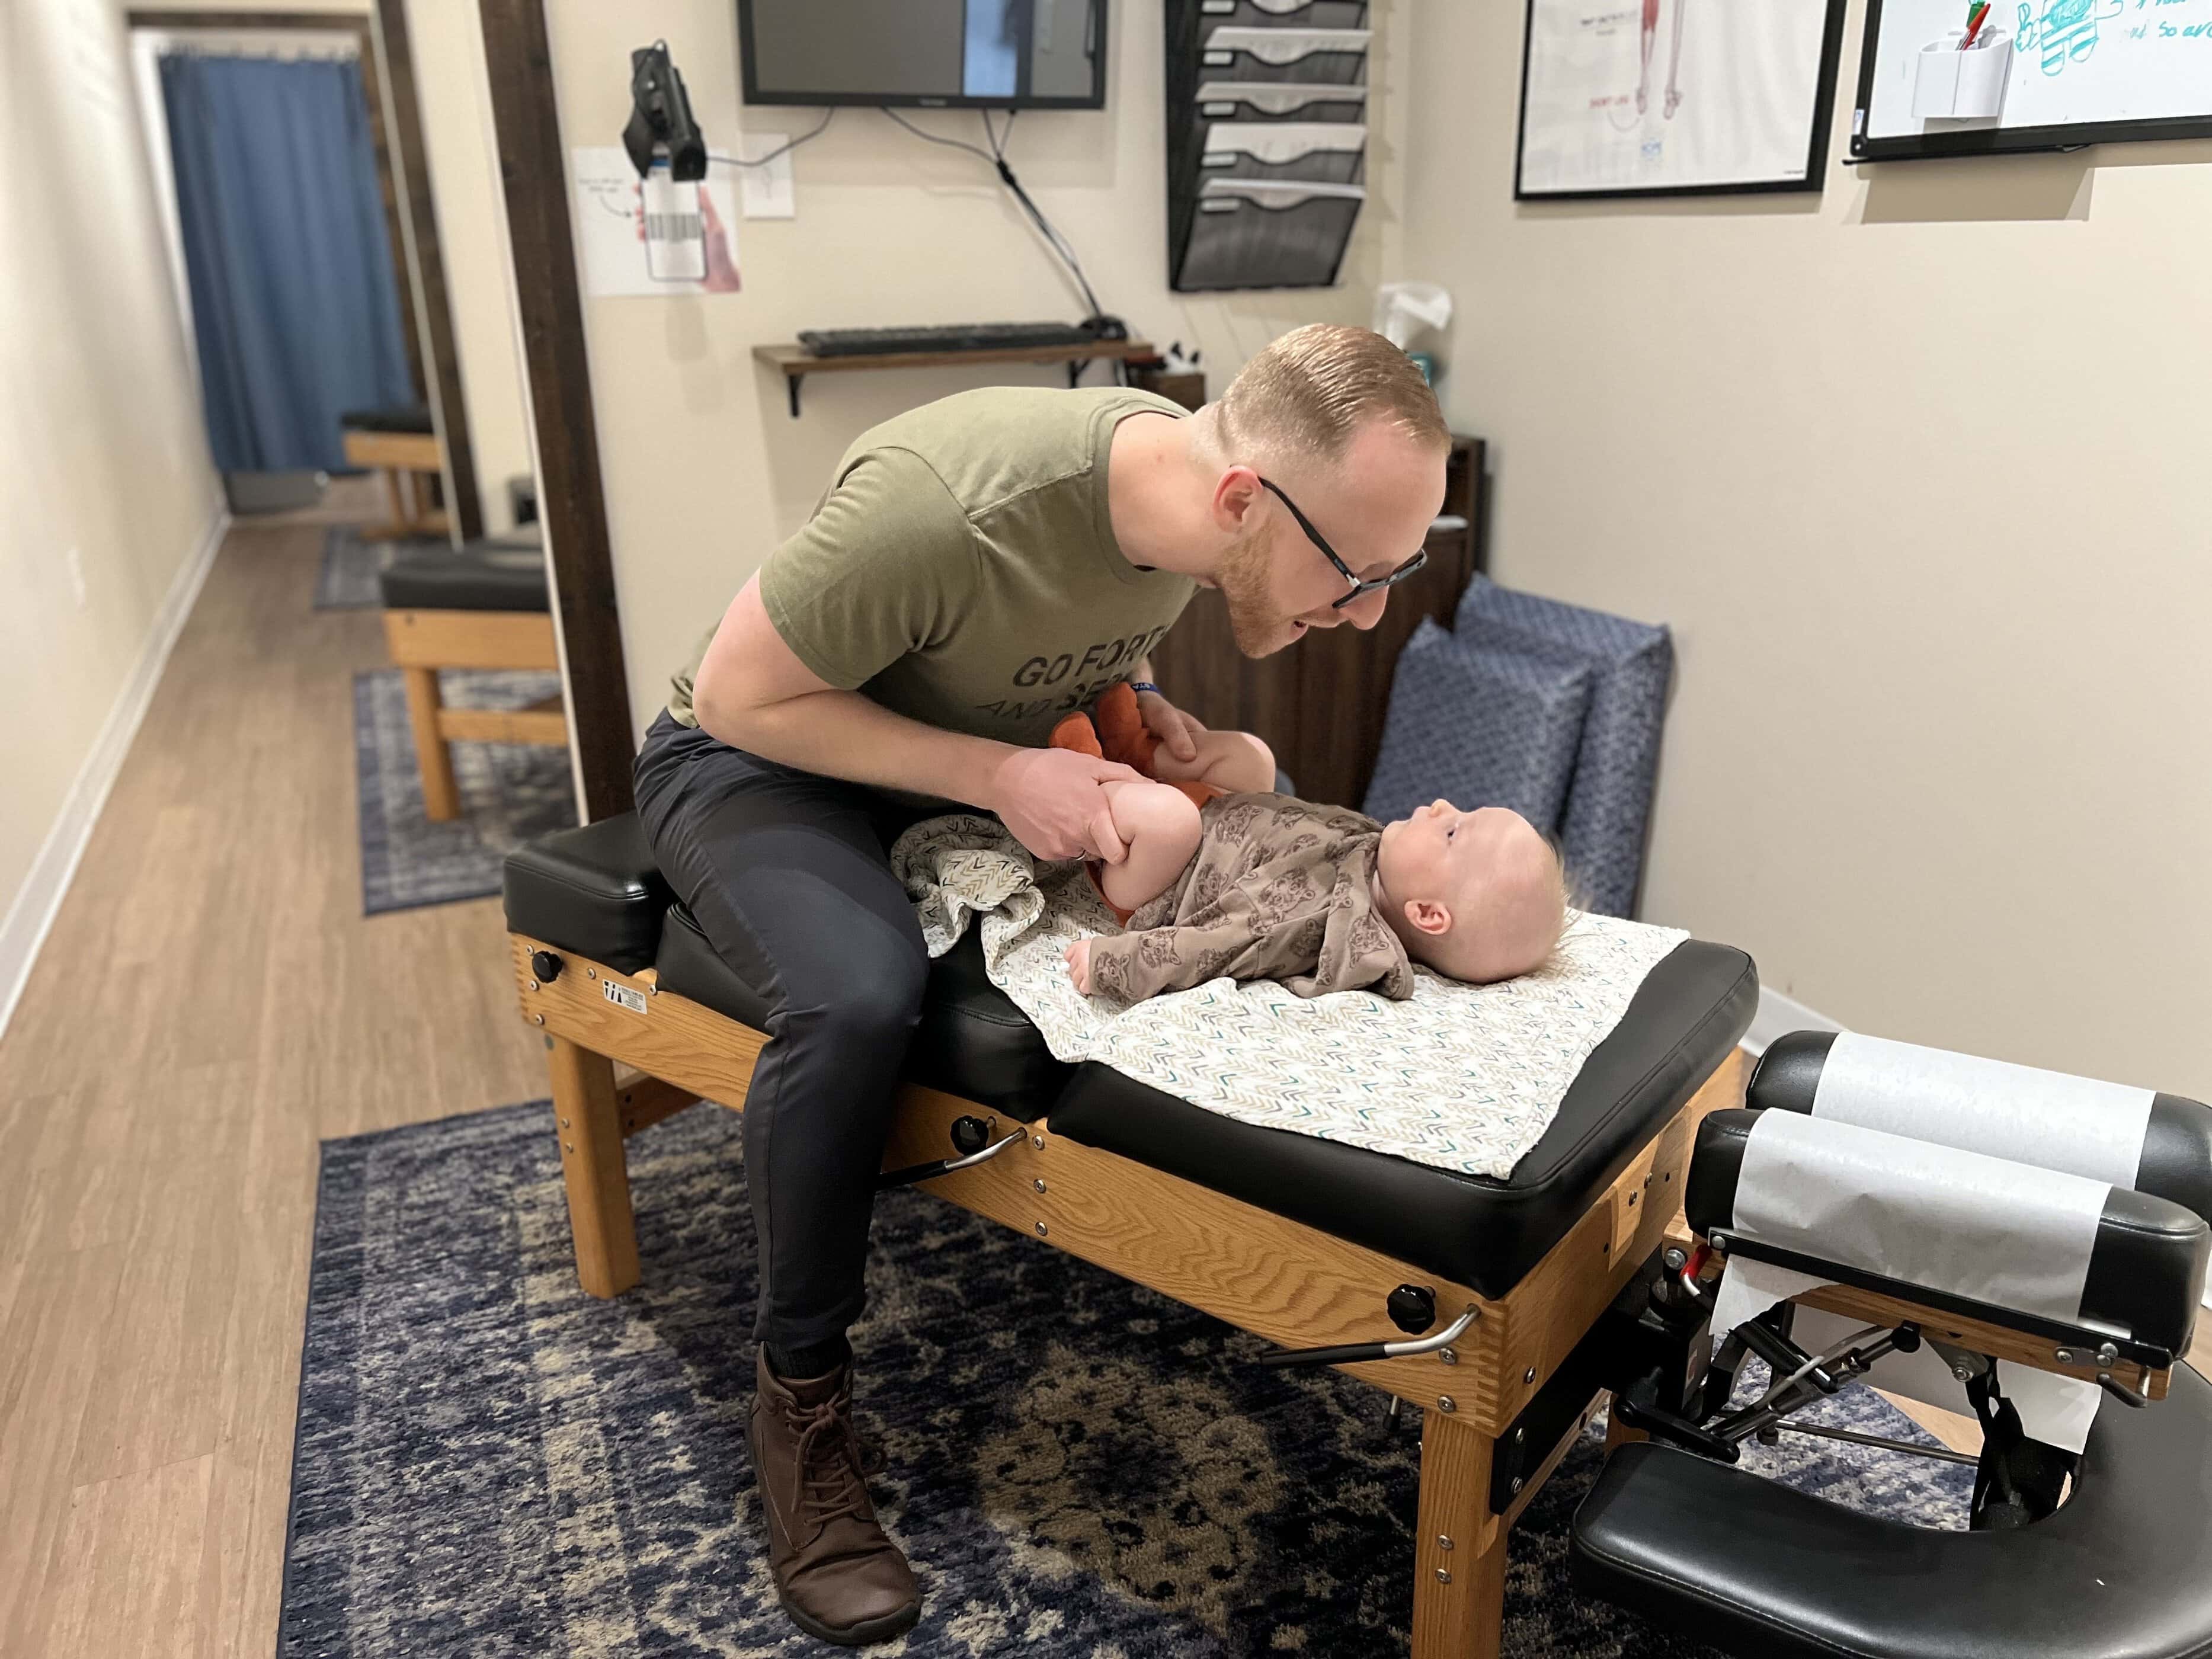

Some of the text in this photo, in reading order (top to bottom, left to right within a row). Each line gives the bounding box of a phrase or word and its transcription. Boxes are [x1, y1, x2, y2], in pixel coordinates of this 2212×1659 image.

[2158, 21, 2177, 37] So
[1013, 624, 1171, 687] GO FORT
[974, 671, 1131, 719] AND SER
